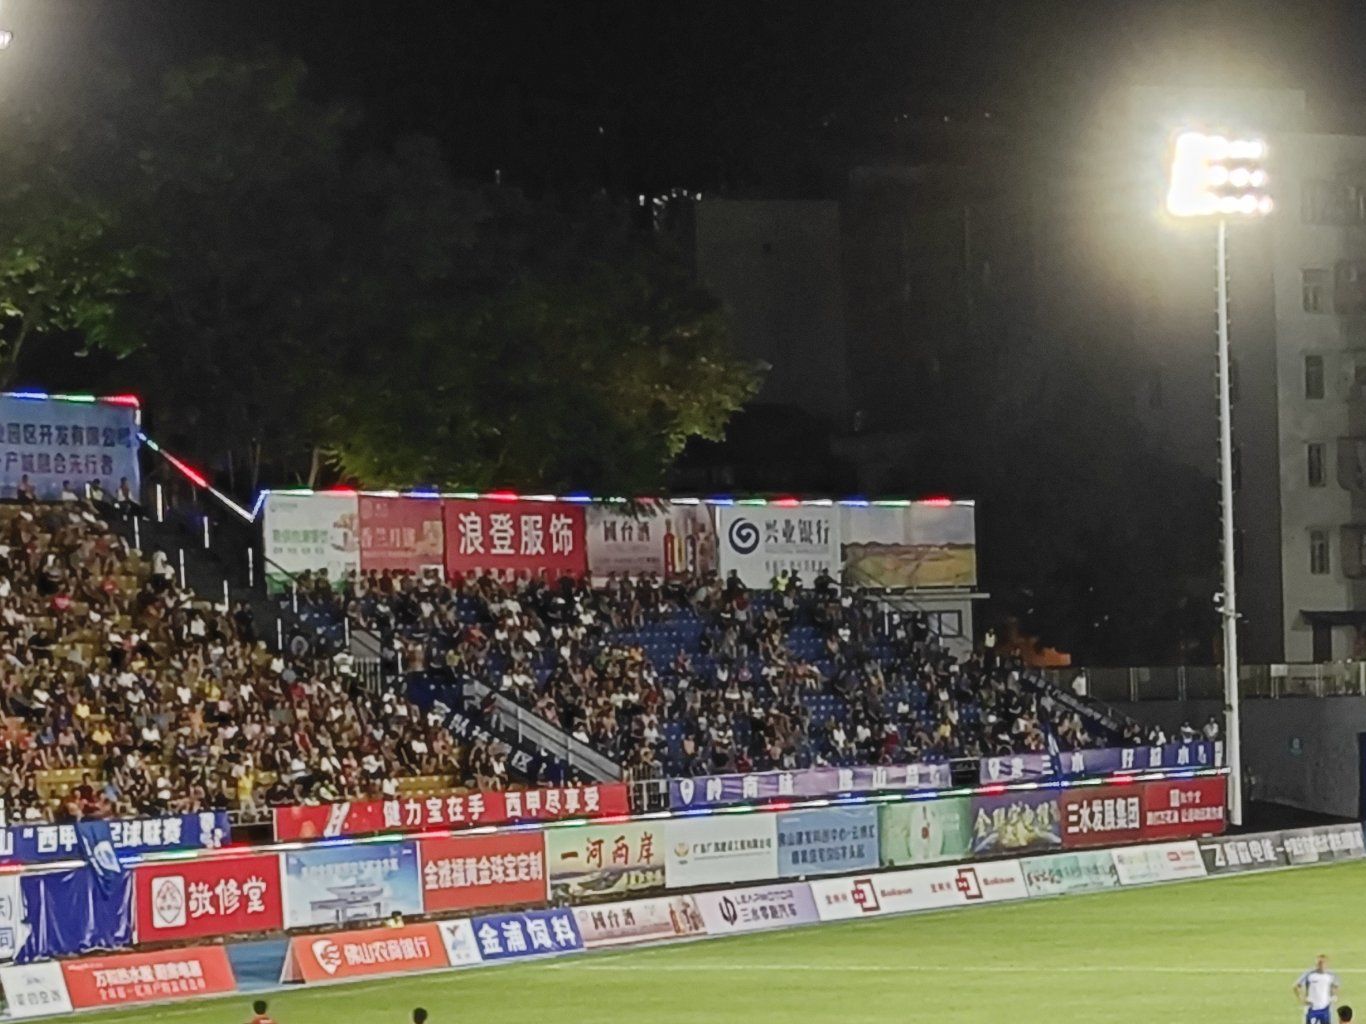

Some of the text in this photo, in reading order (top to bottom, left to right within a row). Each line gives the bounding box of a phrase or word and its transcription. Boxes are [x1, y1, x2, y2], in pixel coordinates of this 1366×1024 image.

[0, 422, 131, 448] 园区开发有限公司
[458, 512, 574, 556] 浪登服饰
[765, 518, 830, 545] 兴业银行
[383, 786, 600, 828] 健力宝在手 西甲尽享受
[1066, 796, 1140, 834] 三水发展集团
[560, 831, 654, 868] 一河两岸
[188, 875, 267, 919] 敬修堂
